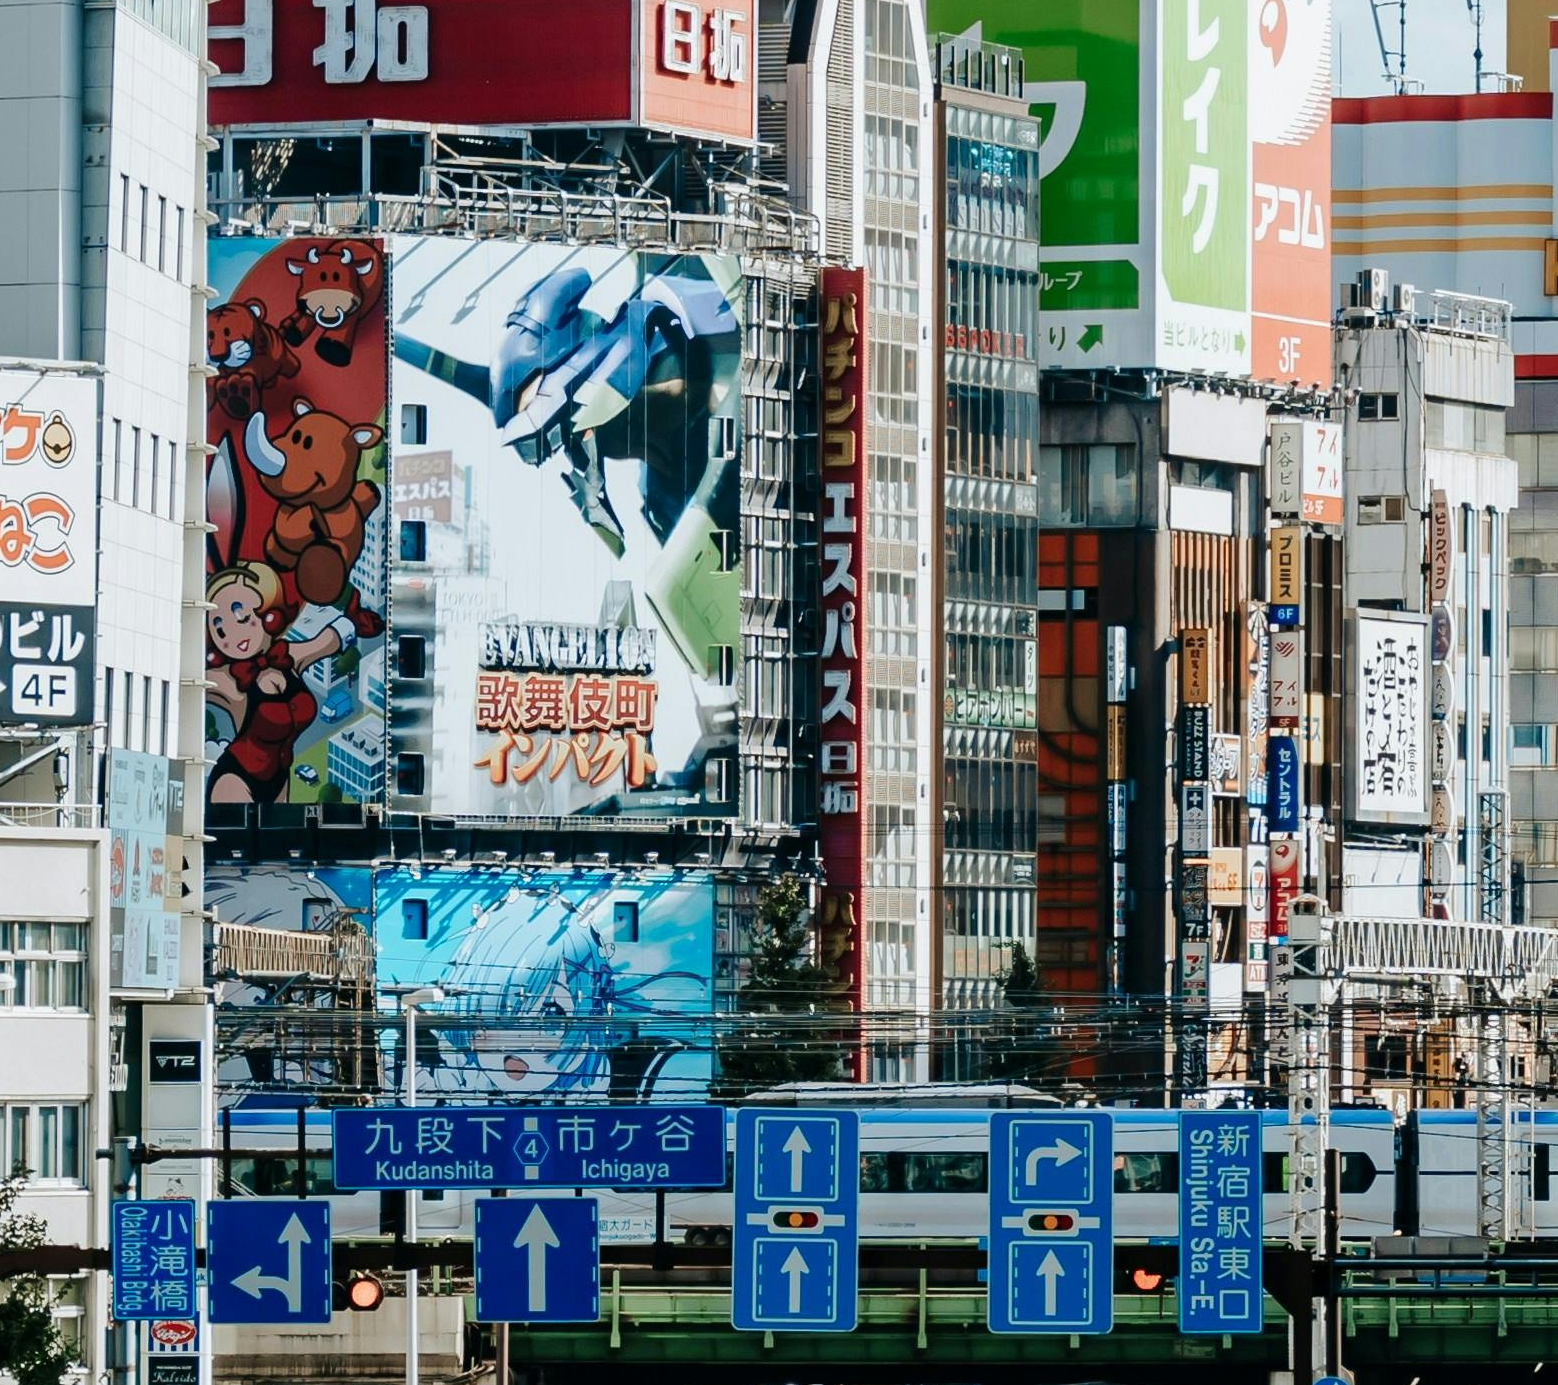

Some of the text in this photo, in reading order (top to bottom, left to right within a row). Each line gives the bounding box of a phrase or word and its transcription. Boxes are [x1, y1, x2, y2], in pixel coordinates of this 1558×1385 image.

[1253, 181, 1326, 250] アコム
[1162, 320, 1232, 354] 当ビルとなり
[1278, 336, 1302, 373] 3F
[393, 472, 452, 503] エスパス
[1276, 432, 1294, 504] 戸谷ビル
[820, 293, 860, 816] パチンコ エスパス 日拓
[1278, 536, 1293, 599] プロミス
[1277, 608, 1293, 620] 6F
[478, 624, 658, 674] EVANGELION
[21, 673, 69, 708] 4F
[475, 674, 659, 733] 歌舞伎町
[1193, 710, 1204, 739] BUZZ
[473, 731, 659, 788] インパクト
[1193, 740, 1204, 779] STAND
[1278, 747, 1292, 820] セントラル
[1185, 922, 1204, 937] 7F
[364, 1115, 505, 1156] 九段下
[523, 1137, 539, 1160] 4
[375, 1160, 495, 1181] Kudanshita
[581, 1159, 670, 1183] Ichigaya
[1189, 1128, 1215, 1228] Shinjuku
[1217, 1123, 1251, 1319] 新宿駅東口
[118, 1206, 148, 1315] Otakibashi Brdg.
[150, 1209, 188, 1313] 小滝橋
